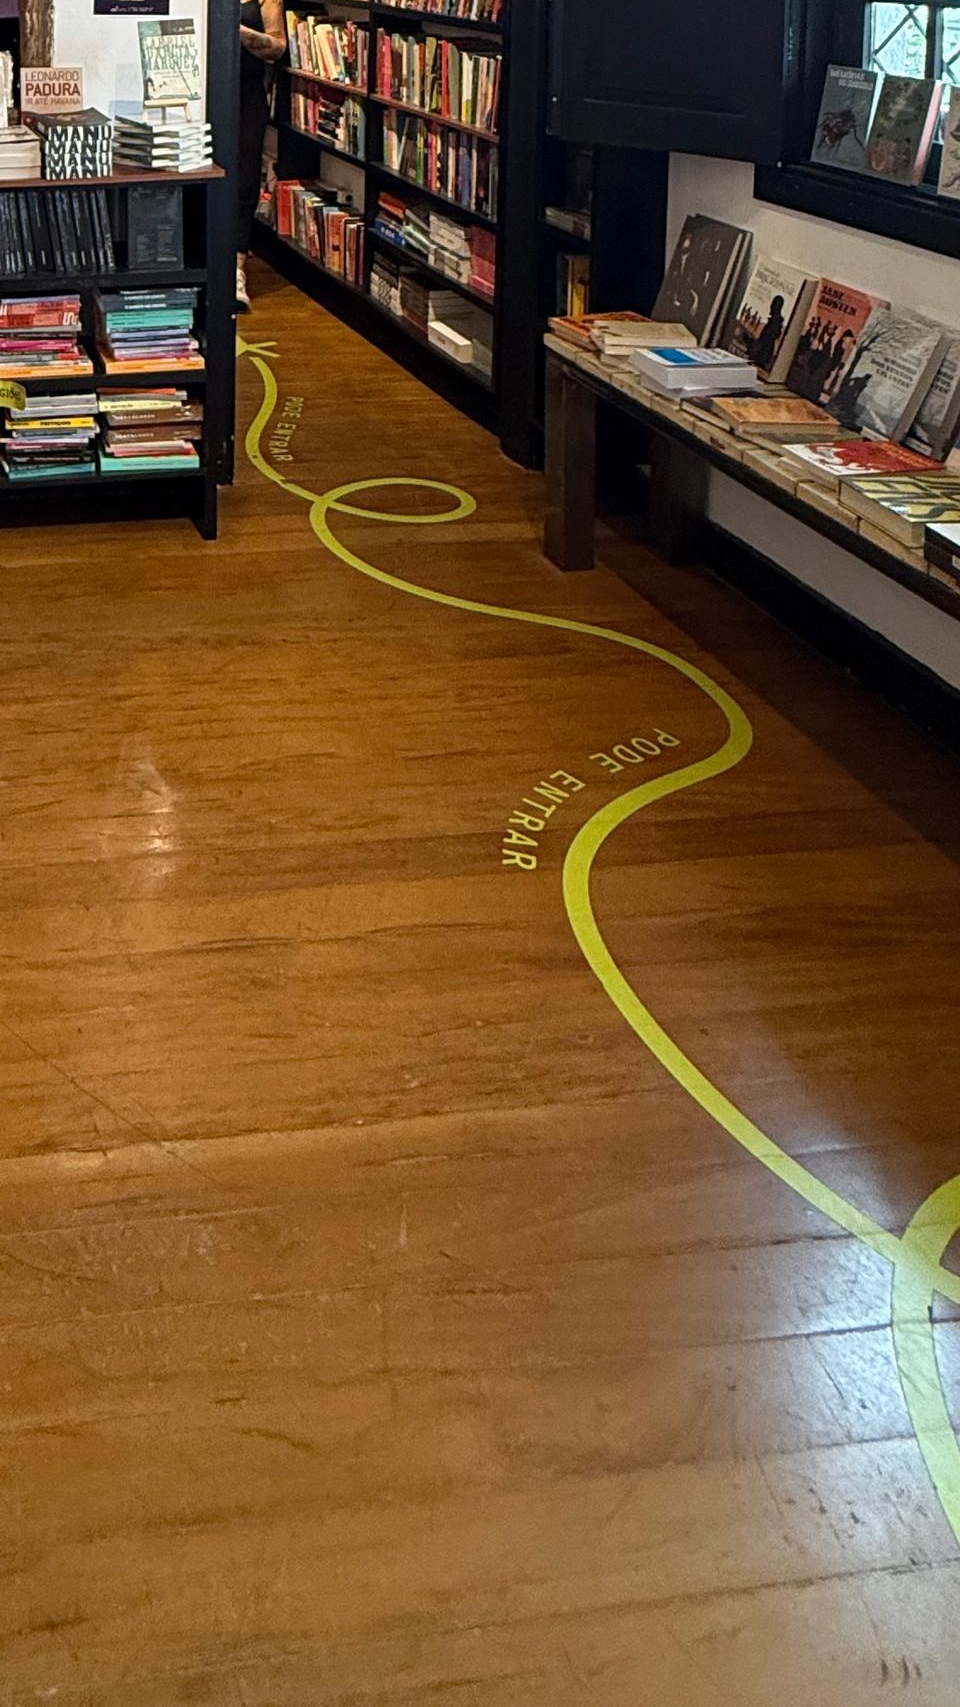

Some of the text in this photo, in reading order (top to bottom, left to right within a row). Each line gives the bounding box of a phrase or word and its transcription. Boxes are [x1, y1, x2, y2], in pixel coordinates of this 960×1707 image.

[24, 71, 80, 82] LEONARDO
[25, 83, 81, 96] PADURA
[268, 396, 304, 462] PODE ENTRAR
[501, 728, 681, 871] PODE ENTRAR
